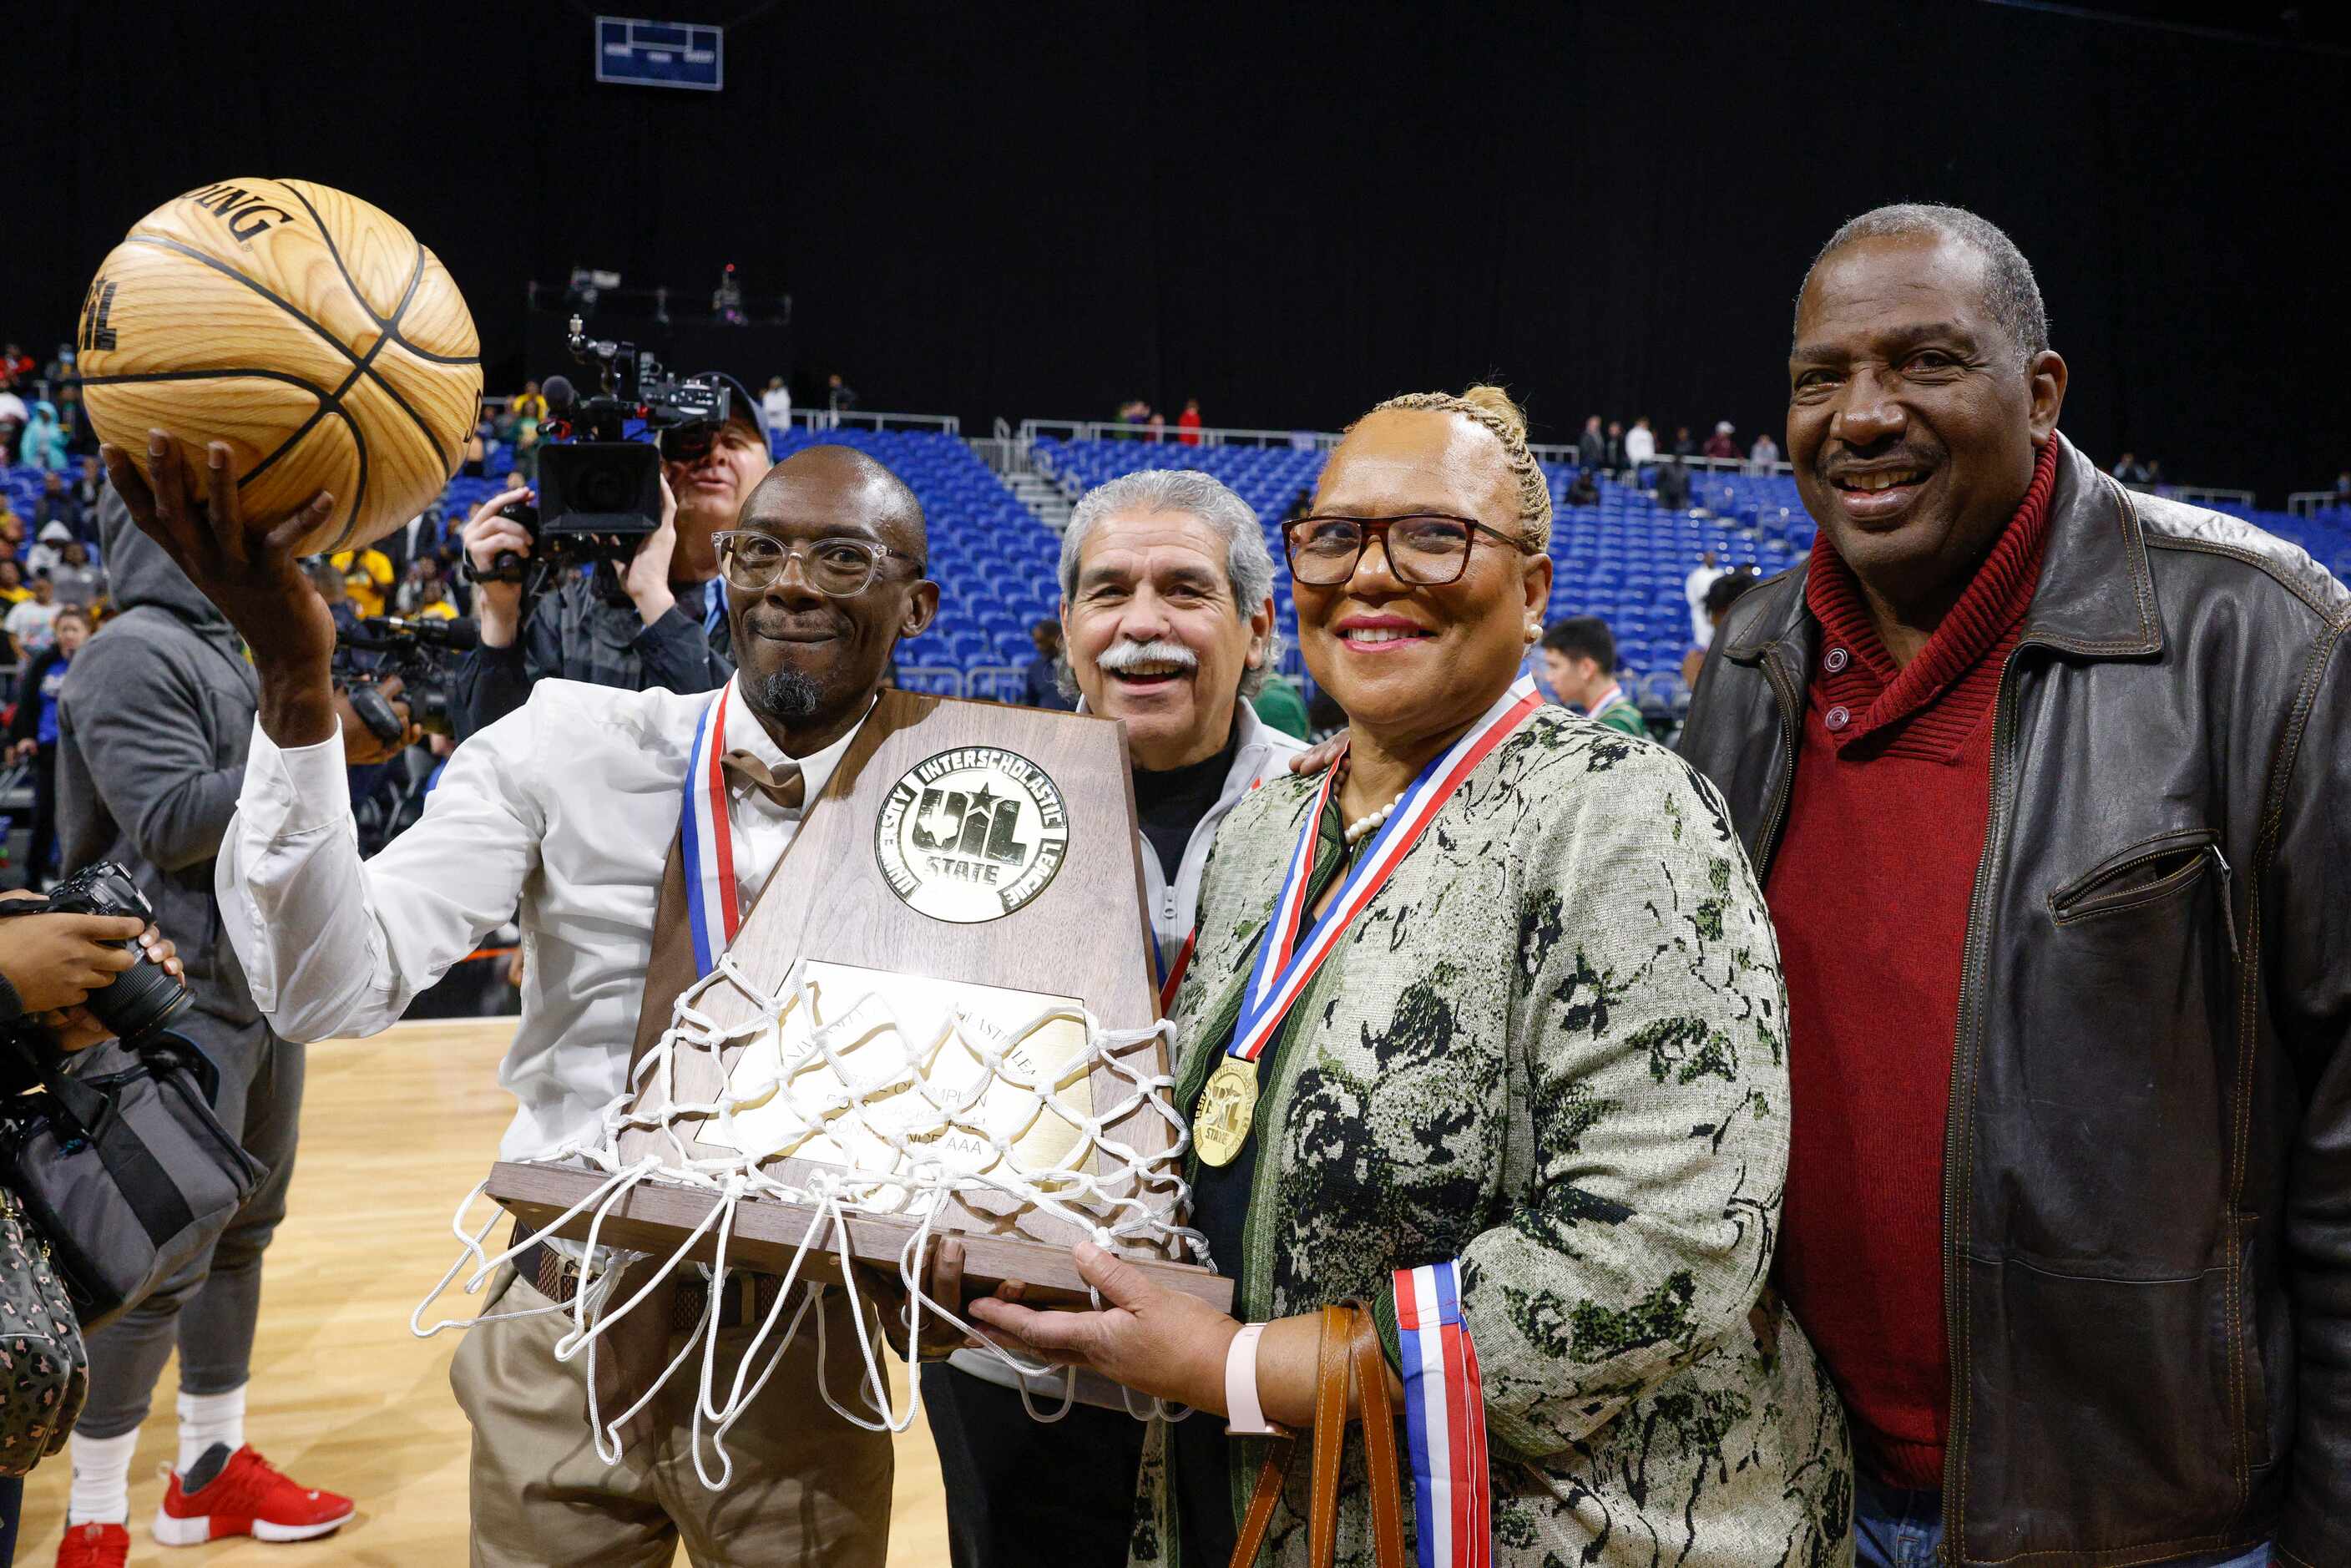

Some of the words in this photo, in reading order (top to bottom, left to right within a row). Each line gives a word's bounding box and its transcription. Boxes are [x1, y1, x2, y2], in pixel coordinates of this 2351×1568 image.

[880, 787, 918, 897] UNIESITY
[918, 750, 1063, 827] INTERSCHOLASTIC
[1003, 842, 1062, 907] LEAGUE
[913, 788, 1027, 867] UIL
[926, 856, 1000, 886] STATE
[945, 1136, 982, 1156] AAA
